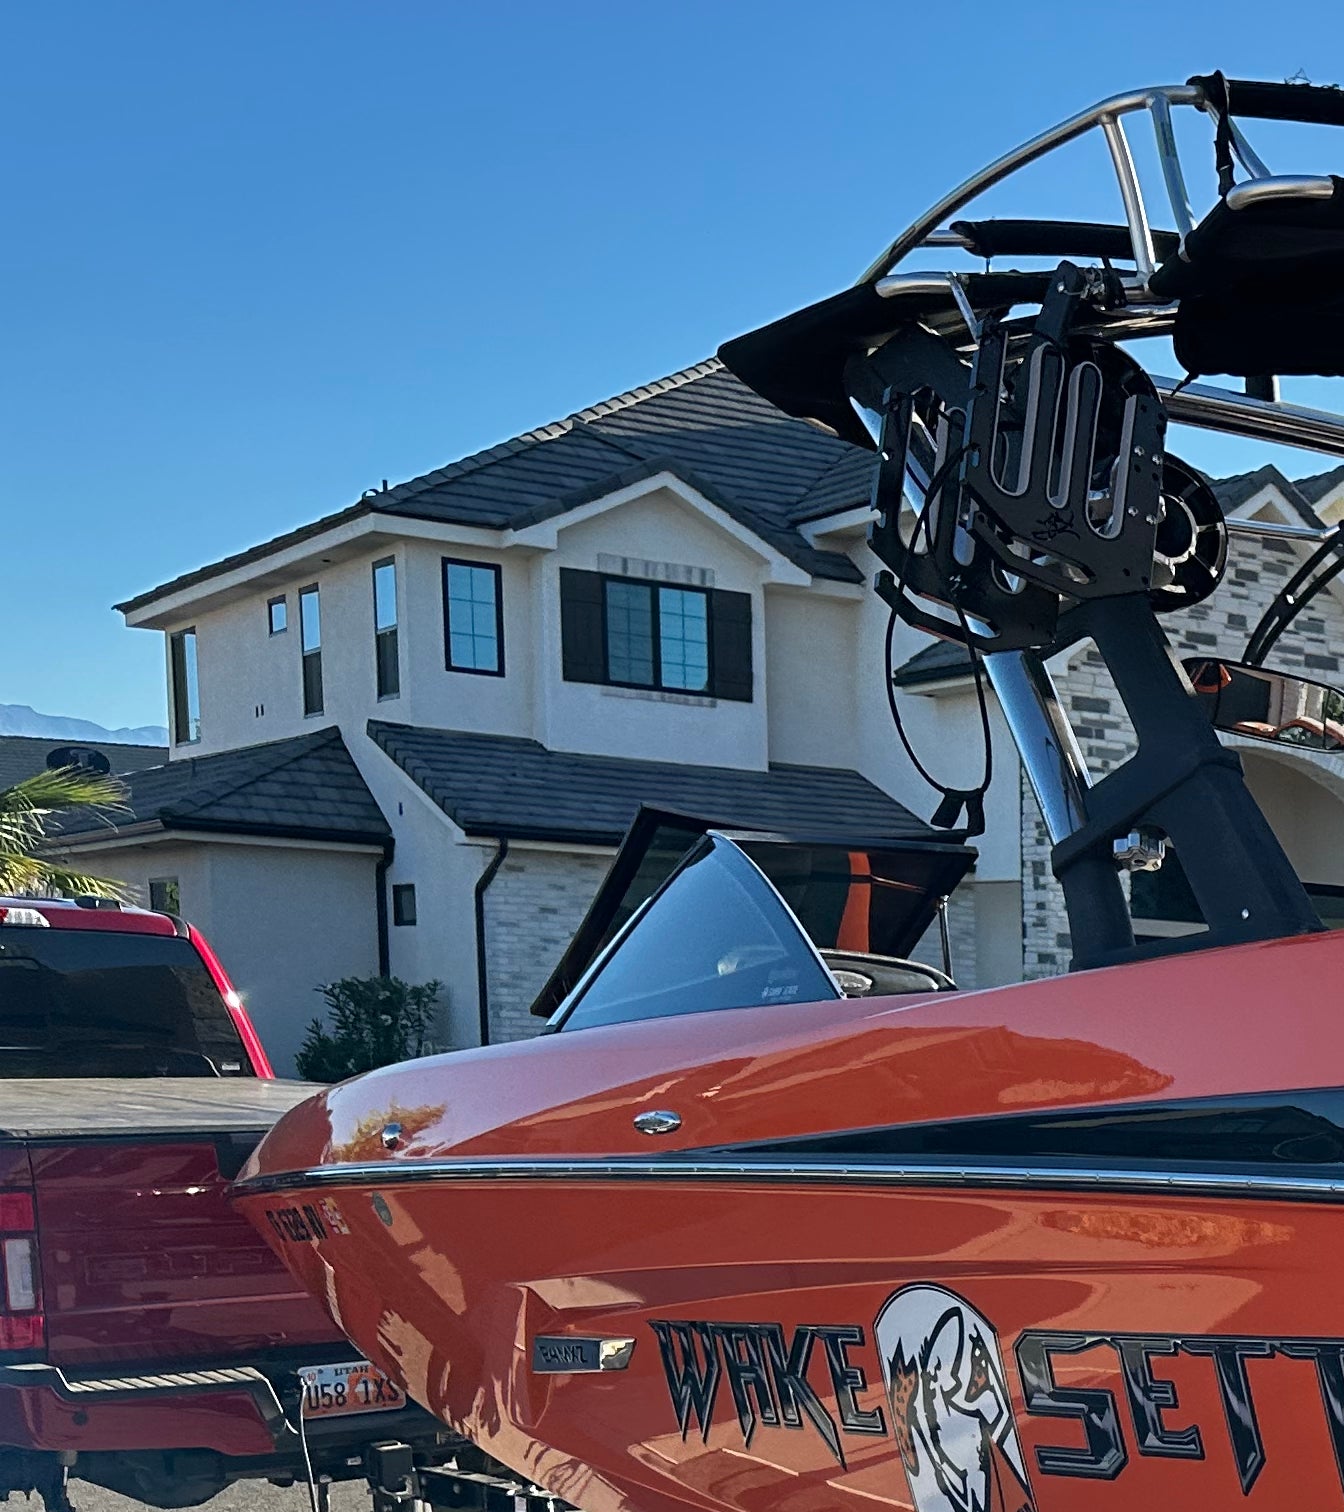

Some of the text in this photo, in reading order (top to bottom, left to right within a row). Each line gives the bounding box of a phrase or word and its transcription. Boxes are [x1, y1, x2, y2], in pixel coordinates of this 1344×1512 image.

[334, 1365, 369, 1377] UTAH
[306, 1382, 347, 1411] U58
[648, 1319, 887, 1472] WAKE
